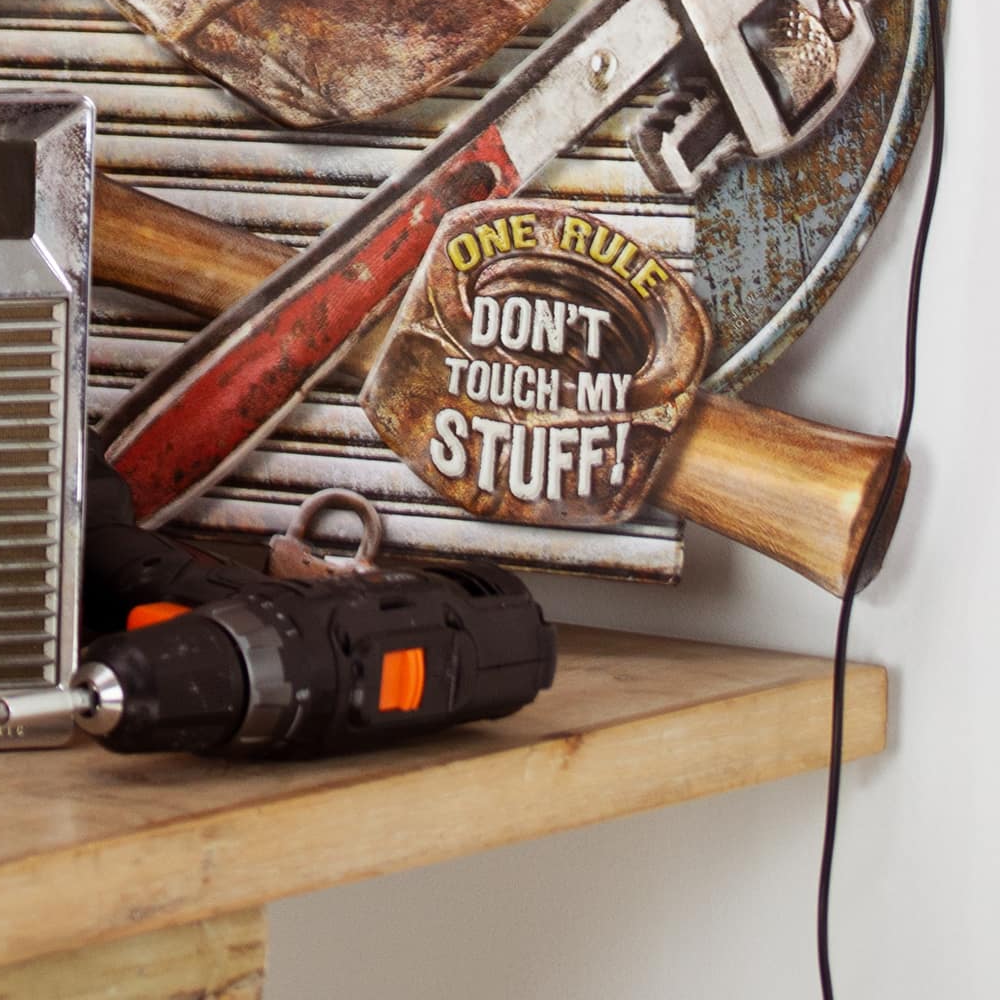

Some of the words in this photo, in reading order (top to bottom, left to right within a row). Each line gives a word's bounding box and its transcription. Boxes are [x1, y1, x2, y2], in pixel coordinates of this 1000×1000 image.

[446, 213, 537, 272] ONE
[560, 215, 670, 298] RULE
[470, 295, 611, 358] DON'T
[445, 357, 559, 412] TOUCH
[576, 371, 632, 413] MY
[429, 408, 631, 500] STUFF!
